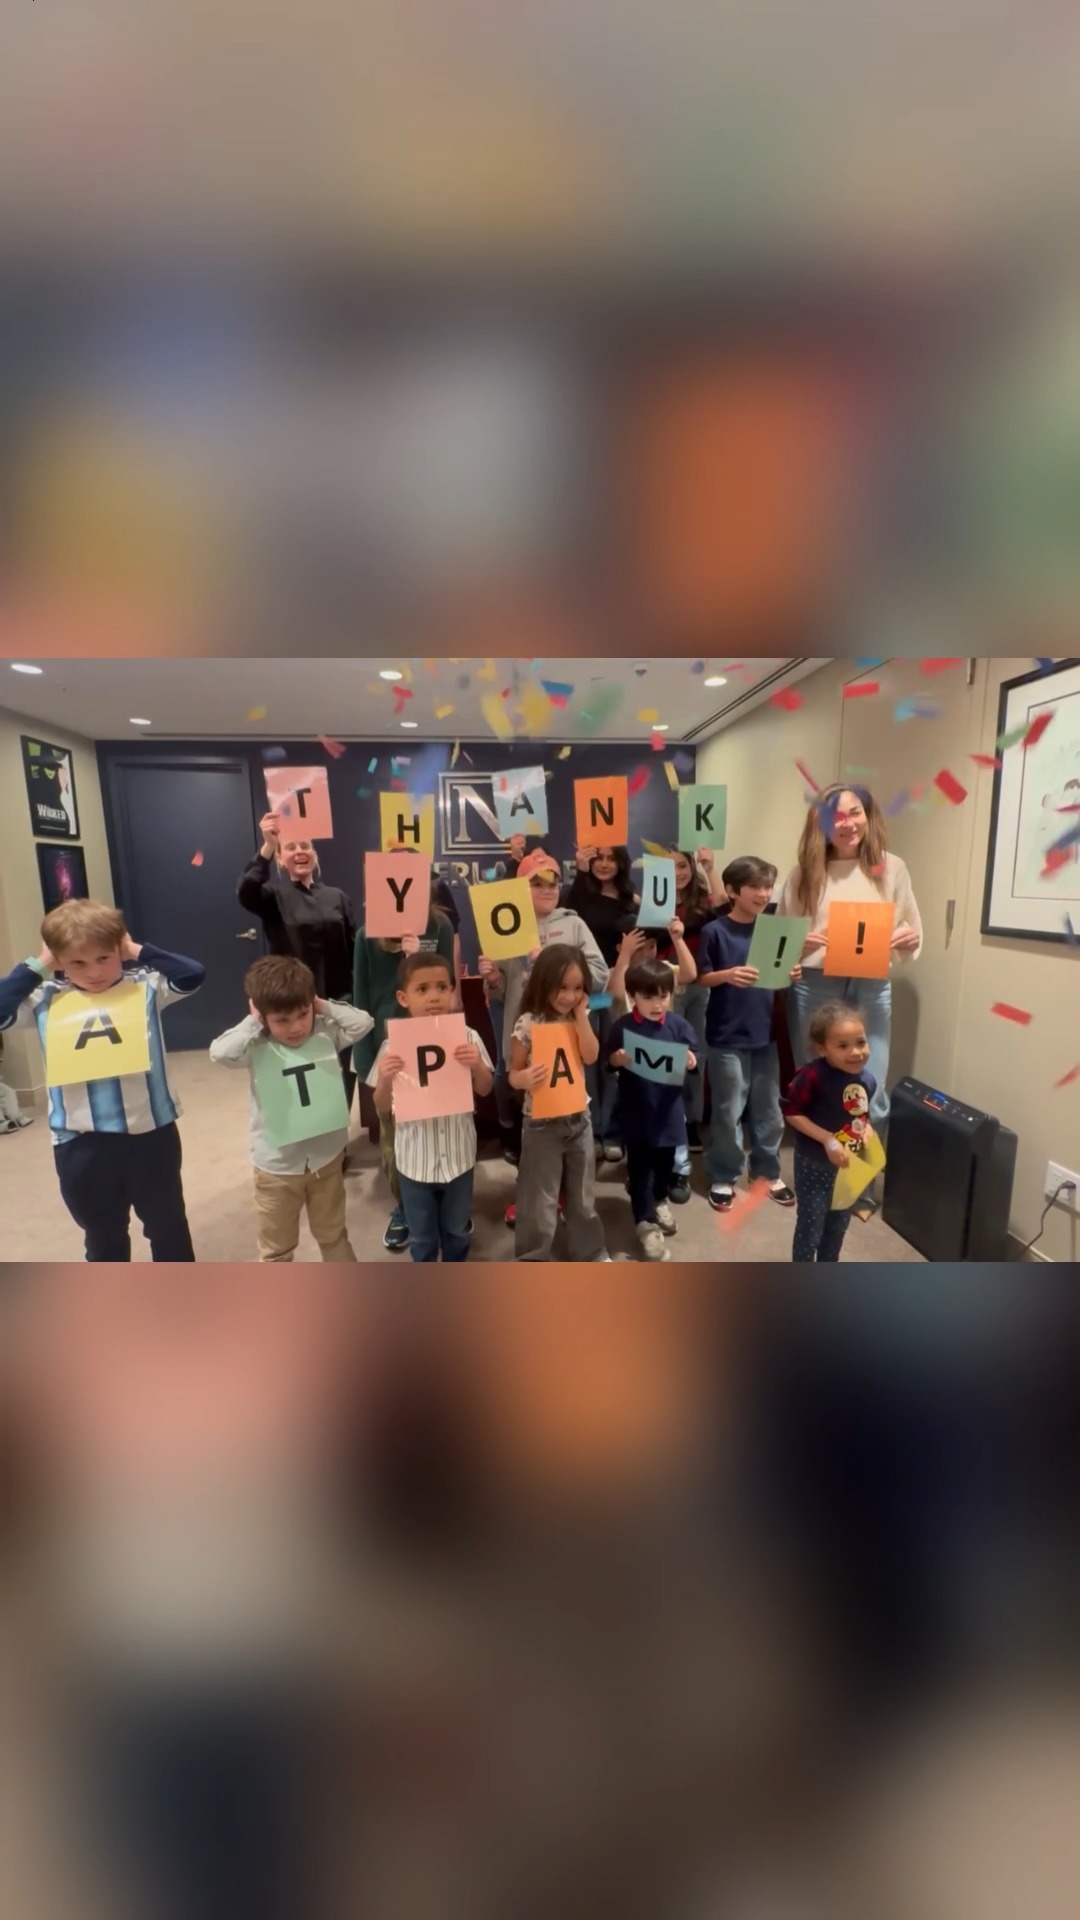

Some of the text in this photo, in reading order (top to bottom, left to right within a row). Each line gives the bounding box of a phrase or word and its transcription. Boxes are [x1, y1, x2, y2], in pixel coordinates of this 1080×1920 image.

[291, 788, 312, 819] T
[510, 787, 535, 818] A
[590, 797, 614, 827] N
[695, 803, 714, 832] K
[397, 813, 420, 843] H
[386, 877, 413, 913] Y
[653, 875, 668, 907] U
[490, 902, 521, 936] O
[774, 935, 787, 968] !
[855, 921, 866, 955] !
[74, 1012, 123, 1050] A
[416, 1044, 446, 1088] P
[549, 1047, 575, 1088] A
[634, 1046, 674, 1074] M
[281, 1062, 316, 1108] T
